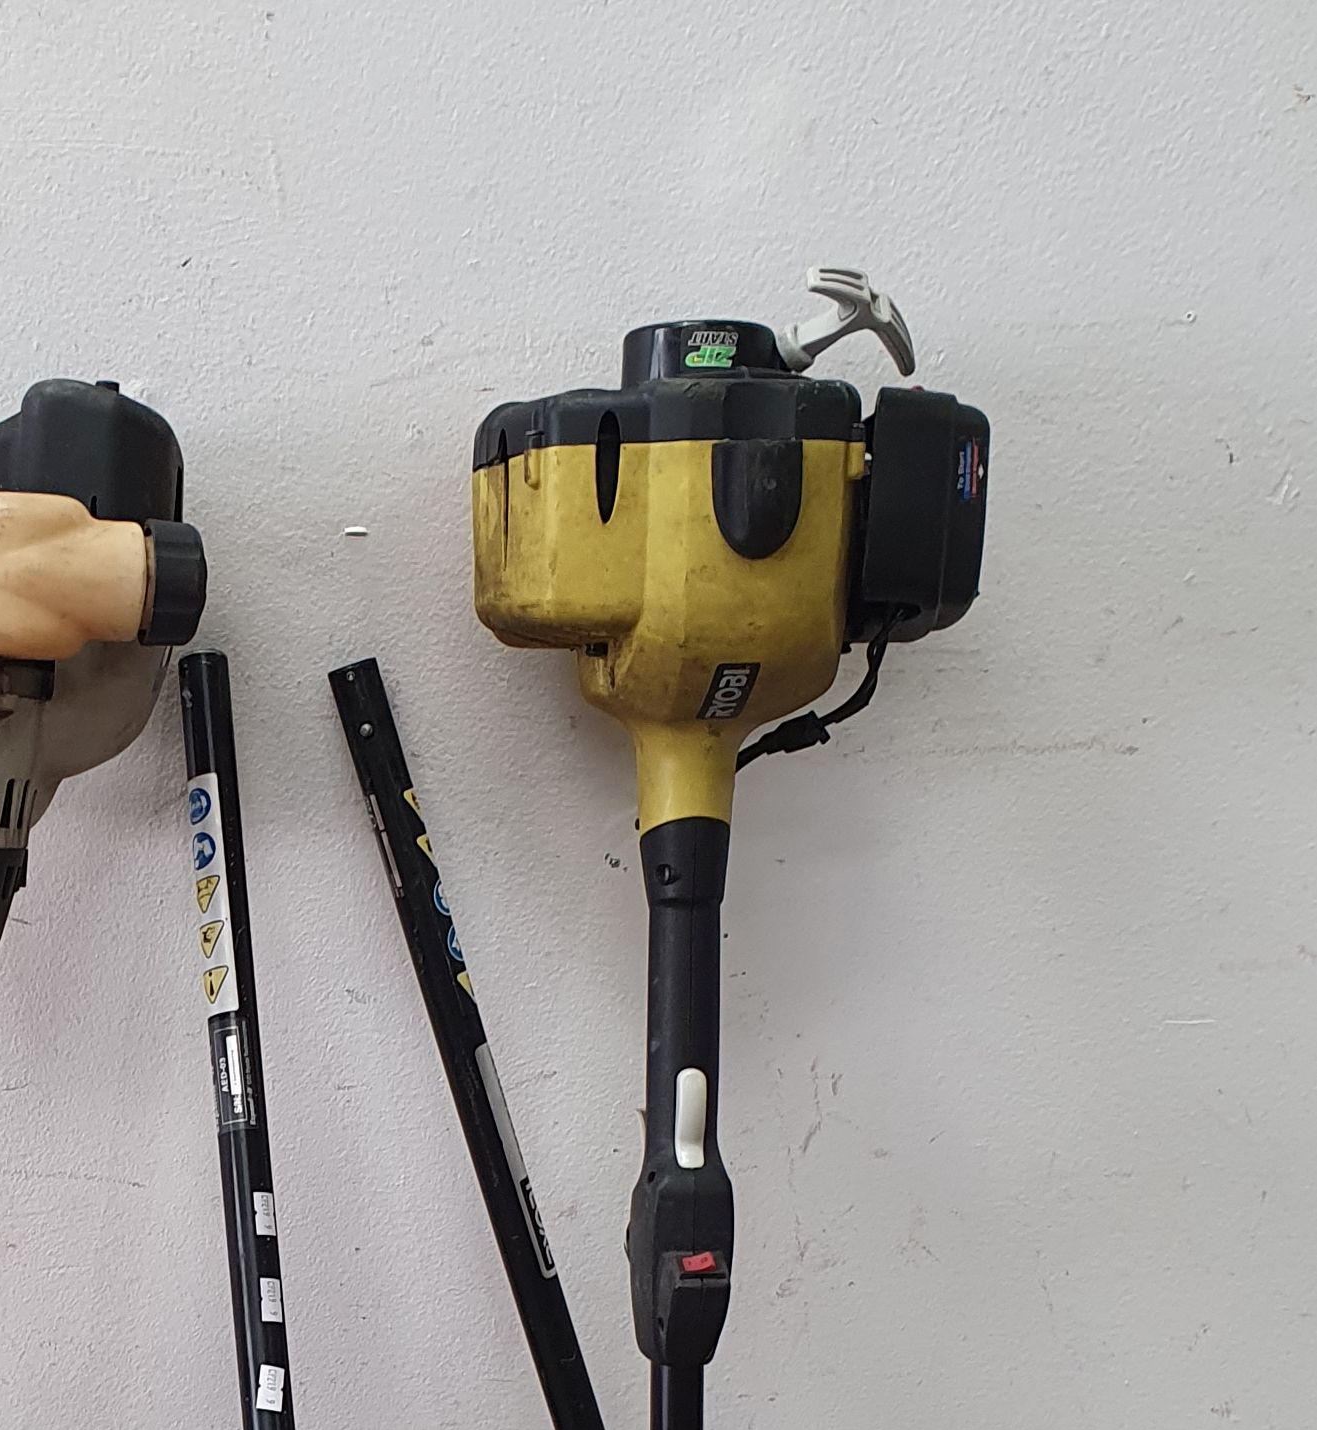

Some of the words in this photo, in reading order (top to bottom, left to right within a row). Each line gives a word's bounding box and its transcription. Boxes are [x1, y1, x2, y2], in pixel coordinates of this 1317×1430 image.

[687, 330, 740, 347] START
[685, 345, 737, 368] ZIP
[704, 668, 751, 719] RYOBI
